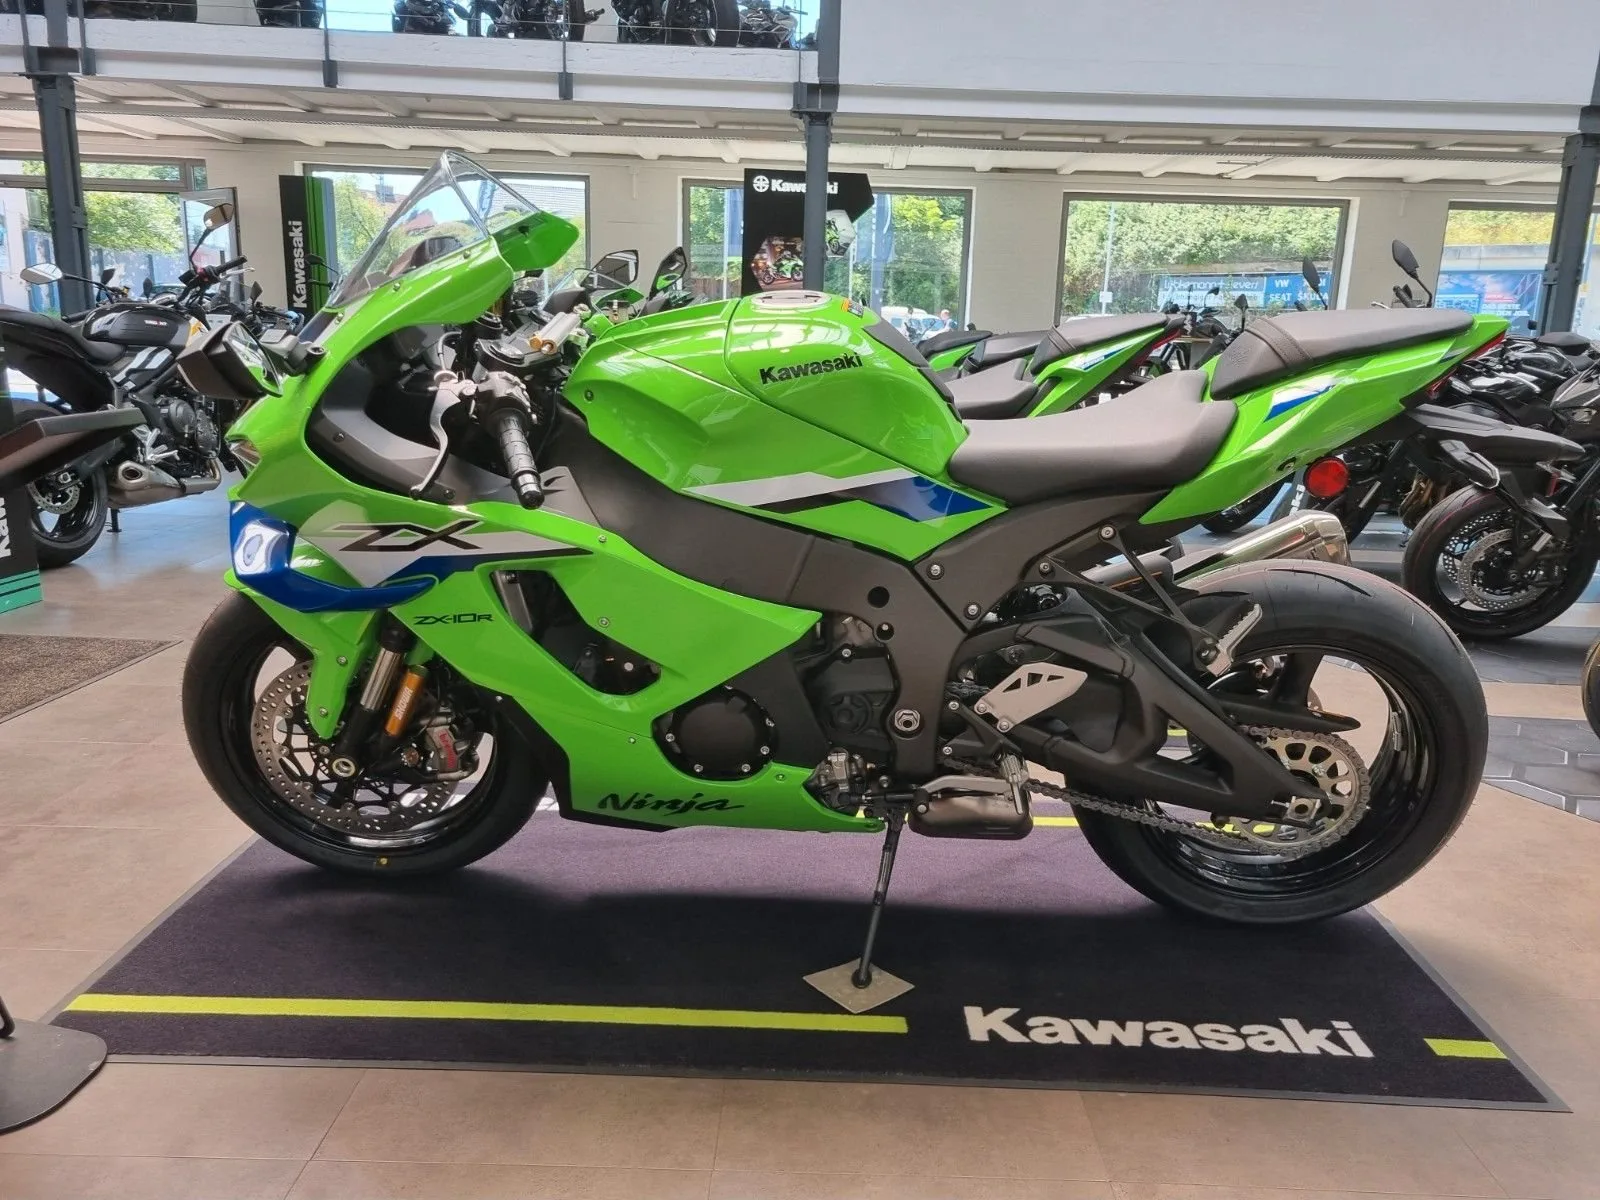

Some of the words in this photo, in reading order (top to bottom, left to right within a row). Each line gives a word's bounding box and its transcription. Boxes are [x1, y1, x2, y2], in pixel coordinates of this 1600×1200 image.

[288, 220, 308, 308] Kawasaki
[1269, 292, 1293, 301] SEAT
[1274, 279, 1290, 288] VW
[759, 352, 863, 385] Kawasaki
[331, 519, 483, 552] ZX
[413, 612, 494, 626] ZX-10R
[597, 792, 745, 817] Ninja
[963, 1005, 1375, 1058] Kawasaki
